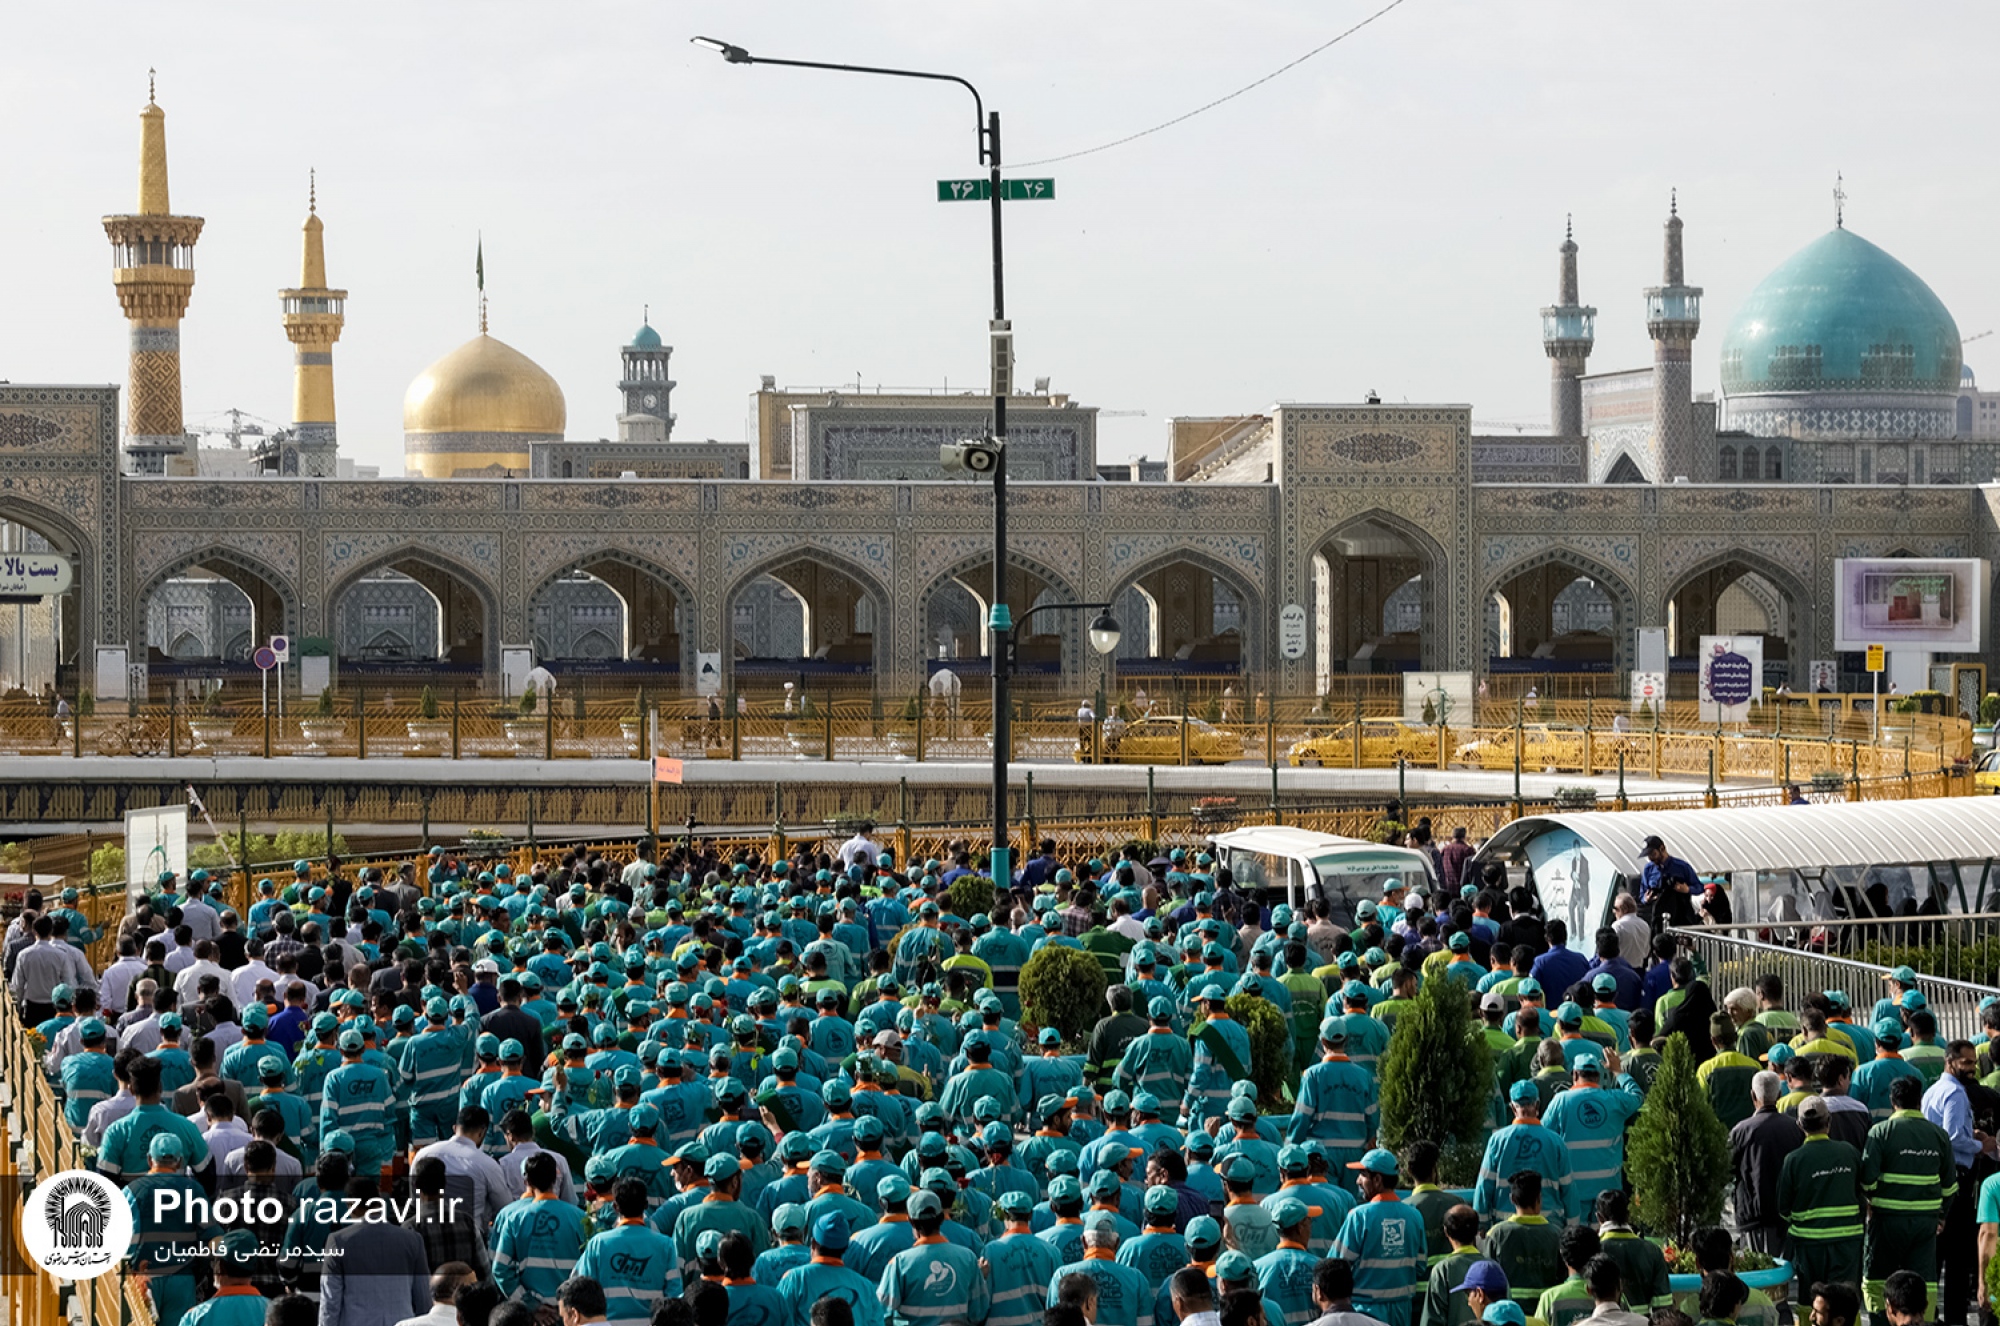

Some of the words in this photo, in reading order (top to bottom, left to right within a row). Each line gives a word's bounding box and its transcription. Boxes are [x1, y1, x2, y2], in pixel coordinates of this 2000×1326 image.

[1023, 182, 1045, 199] ۲۶
[4, 557, 25, 581] بالا
[28, 561, 59, 581] بست
